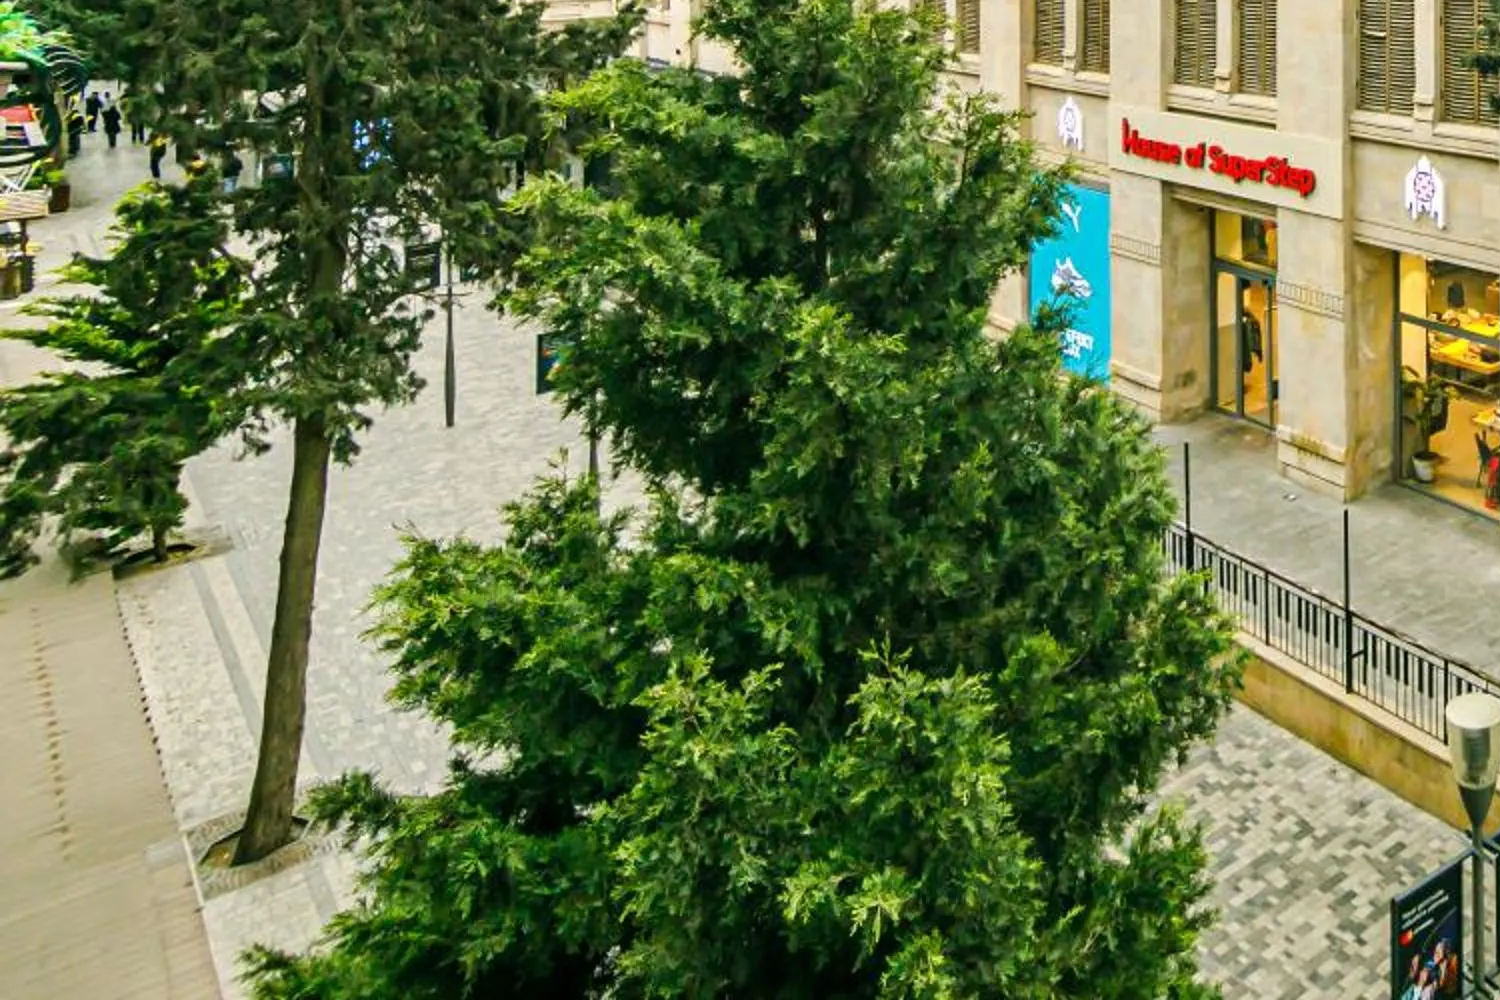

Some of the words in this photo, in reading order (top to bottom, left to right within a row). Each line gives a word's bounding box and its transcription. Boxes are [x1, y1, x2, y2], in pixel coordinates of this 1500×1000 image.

[1121, 117, 1182, 166] House
[1184, 141, 1206, 169] of
[1208, 145, 1316, 198] SuperStep
